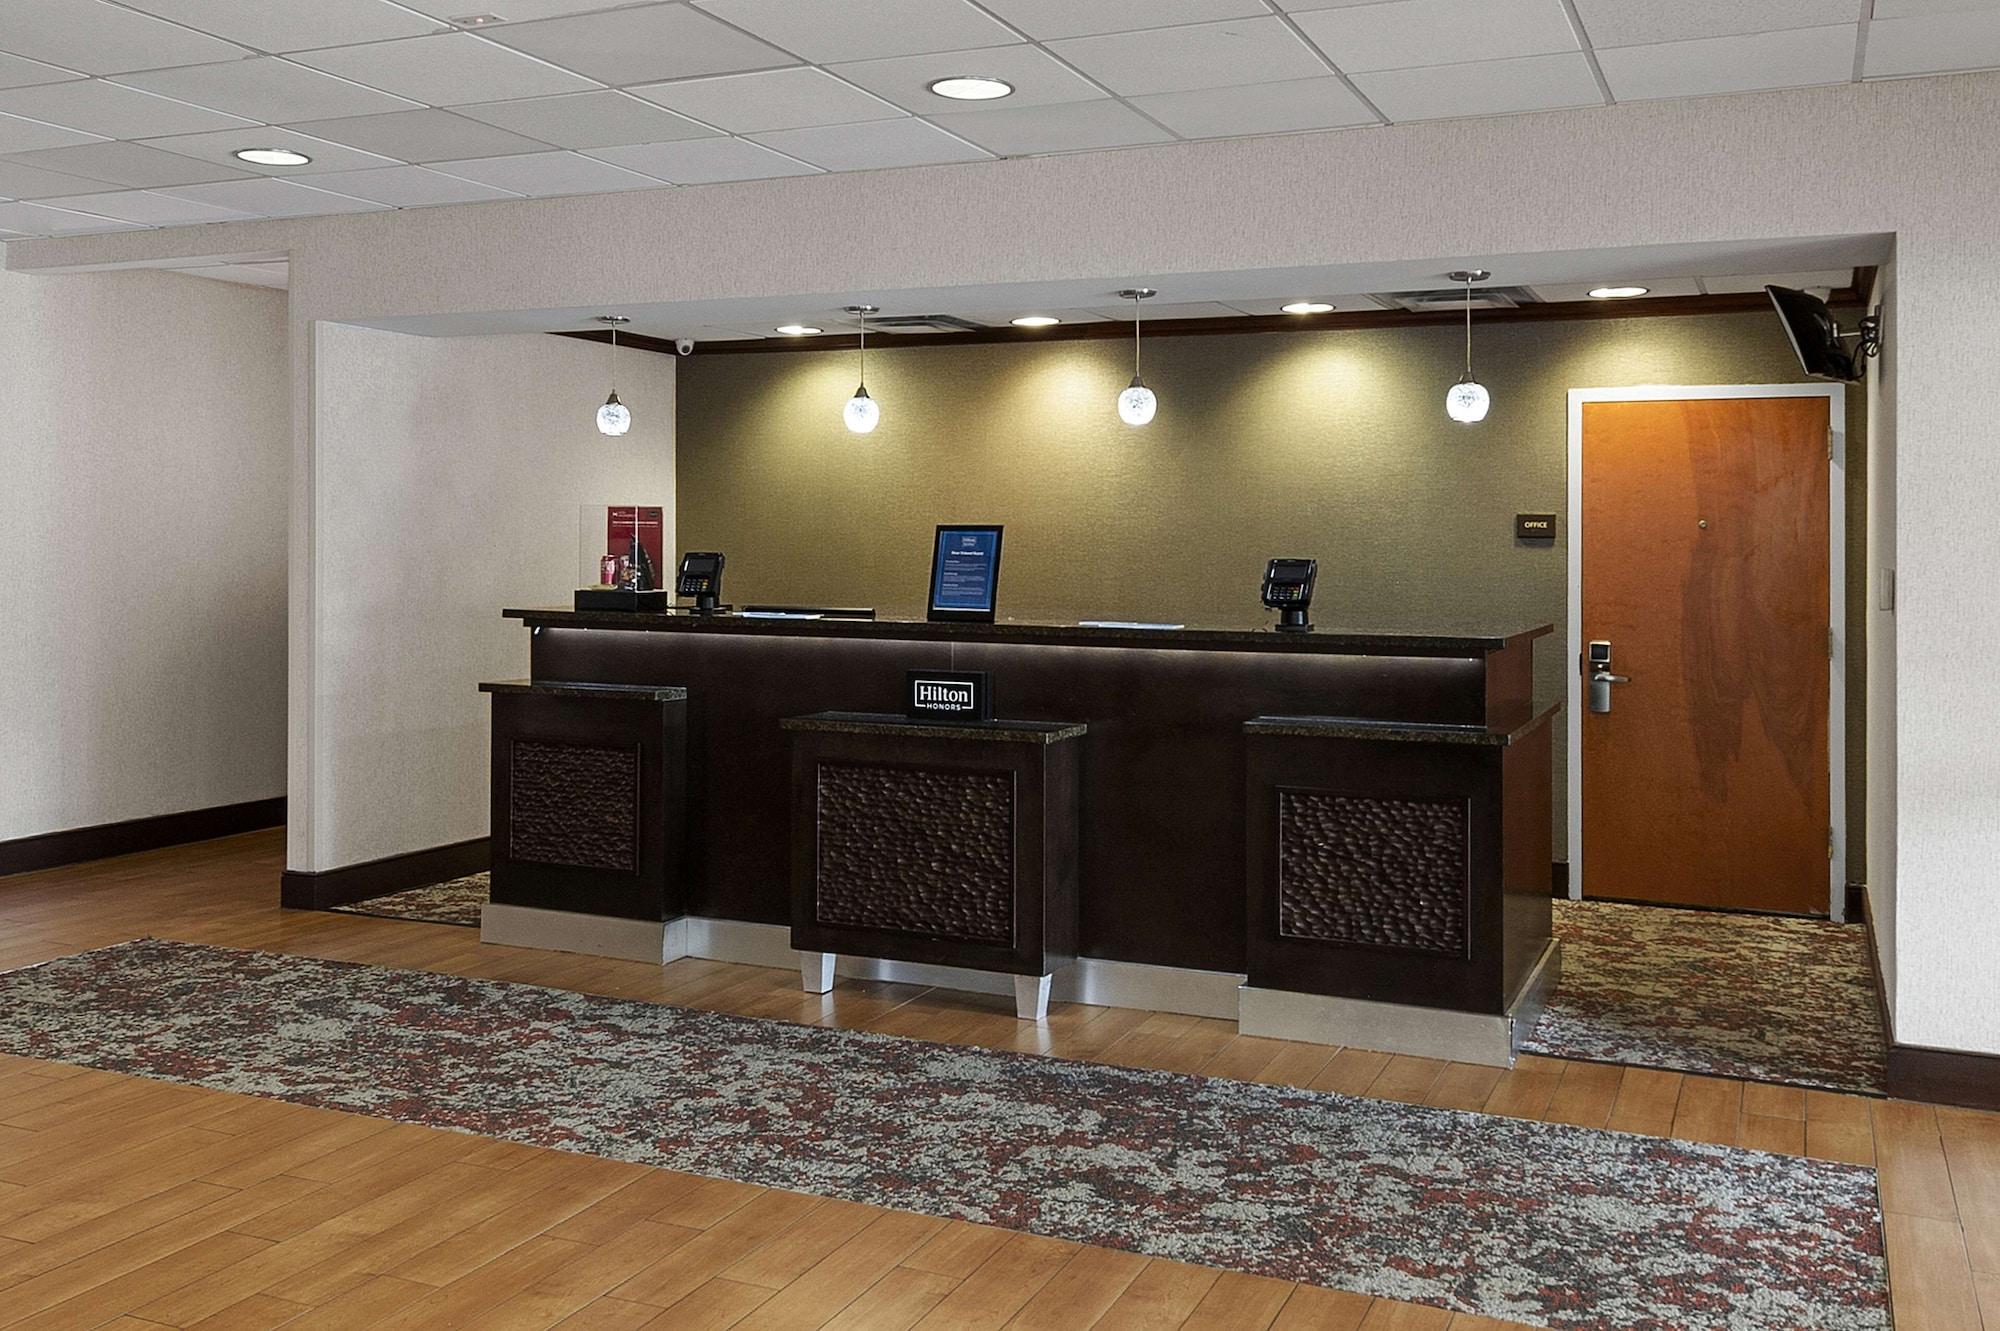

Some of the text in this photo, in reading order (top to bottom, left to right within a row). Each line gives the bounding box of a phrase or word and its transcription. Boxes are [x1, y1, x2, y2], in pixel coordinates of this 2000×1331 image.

[1524, 521, 1548, 529] OFFICE
[919, 685, 968, 702] Hilton
[926, 703, 961, 711] HONORS
